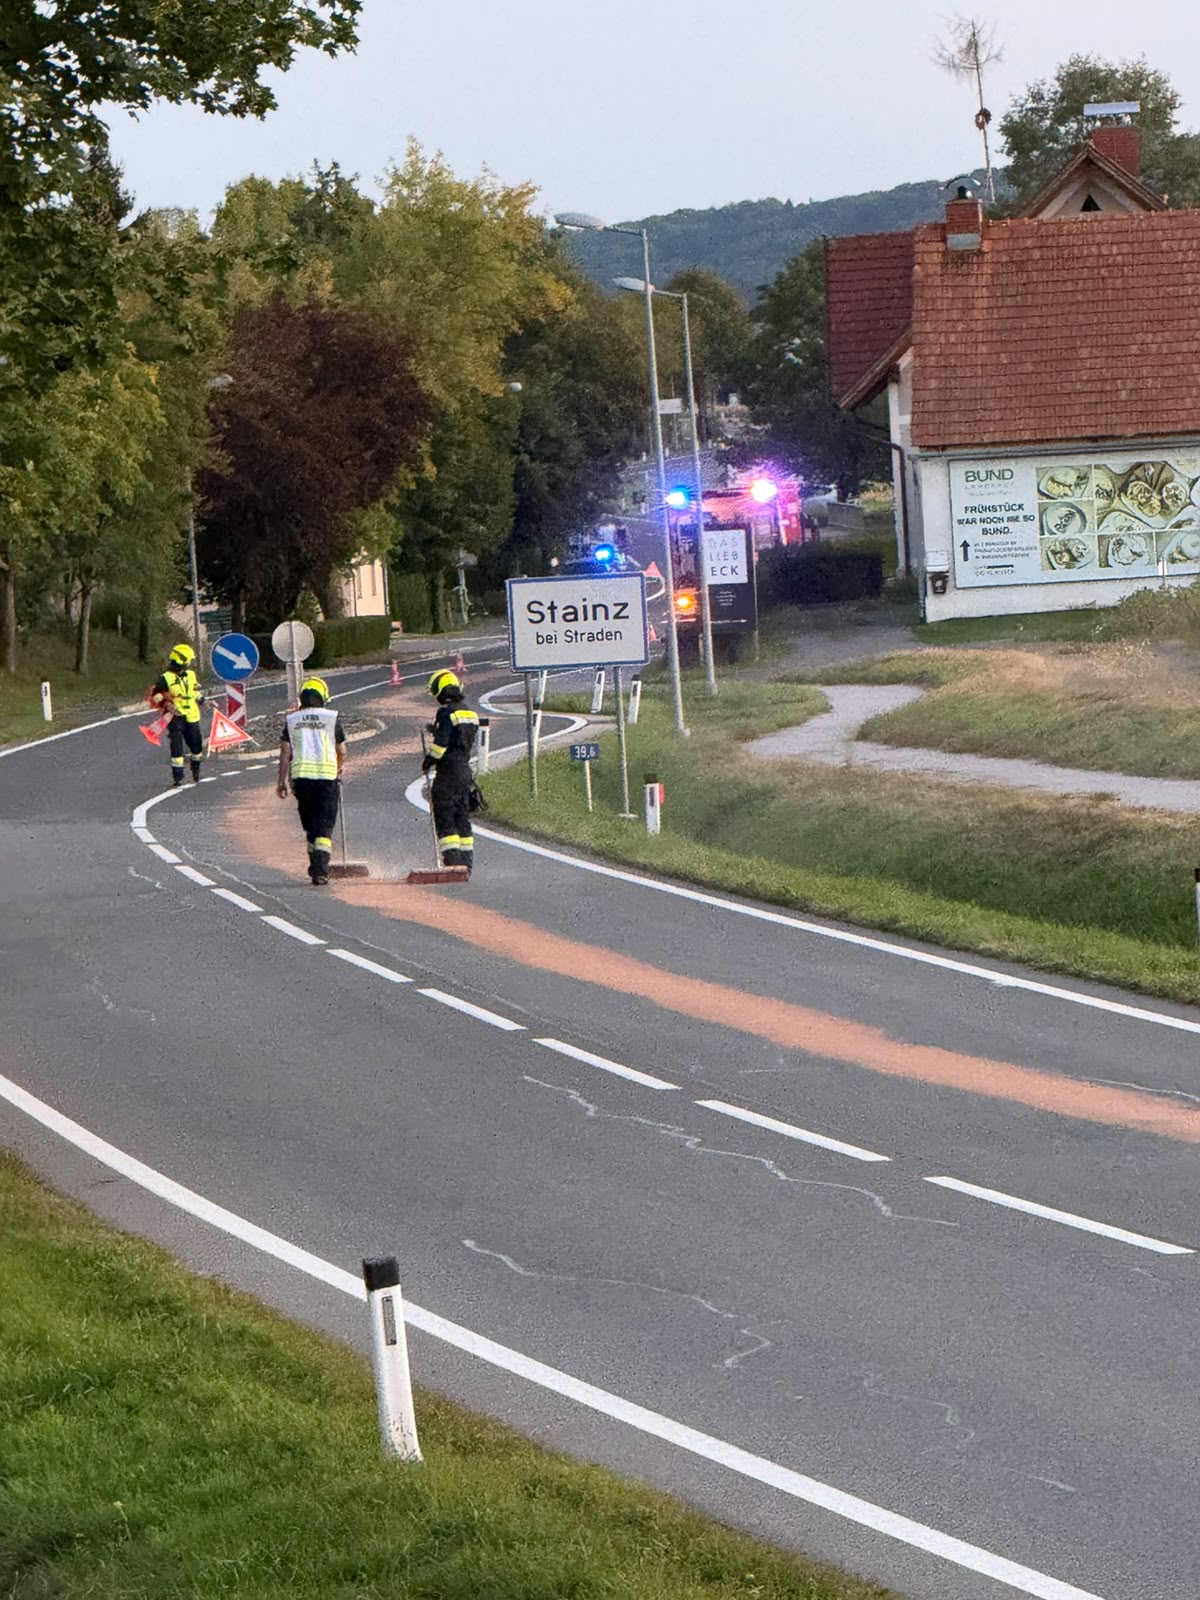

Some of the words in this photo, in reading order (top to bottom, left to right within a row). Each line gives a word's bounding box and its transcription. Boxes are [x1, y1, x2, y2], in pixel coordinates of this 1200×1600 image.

[965, 468, 1014, 483] BUND
[964, 502, 1025, 514] FRÜHSTÜCK
[979, 516, 1005, 525] NOCH
[1022, 514, 1036, 523] SO
[711, 565, 739, 577] ECK
[526, 597, 630, 624] Stainz
[536, 630, 558, 645] bei
[564, 628, 623, 644] Straden
